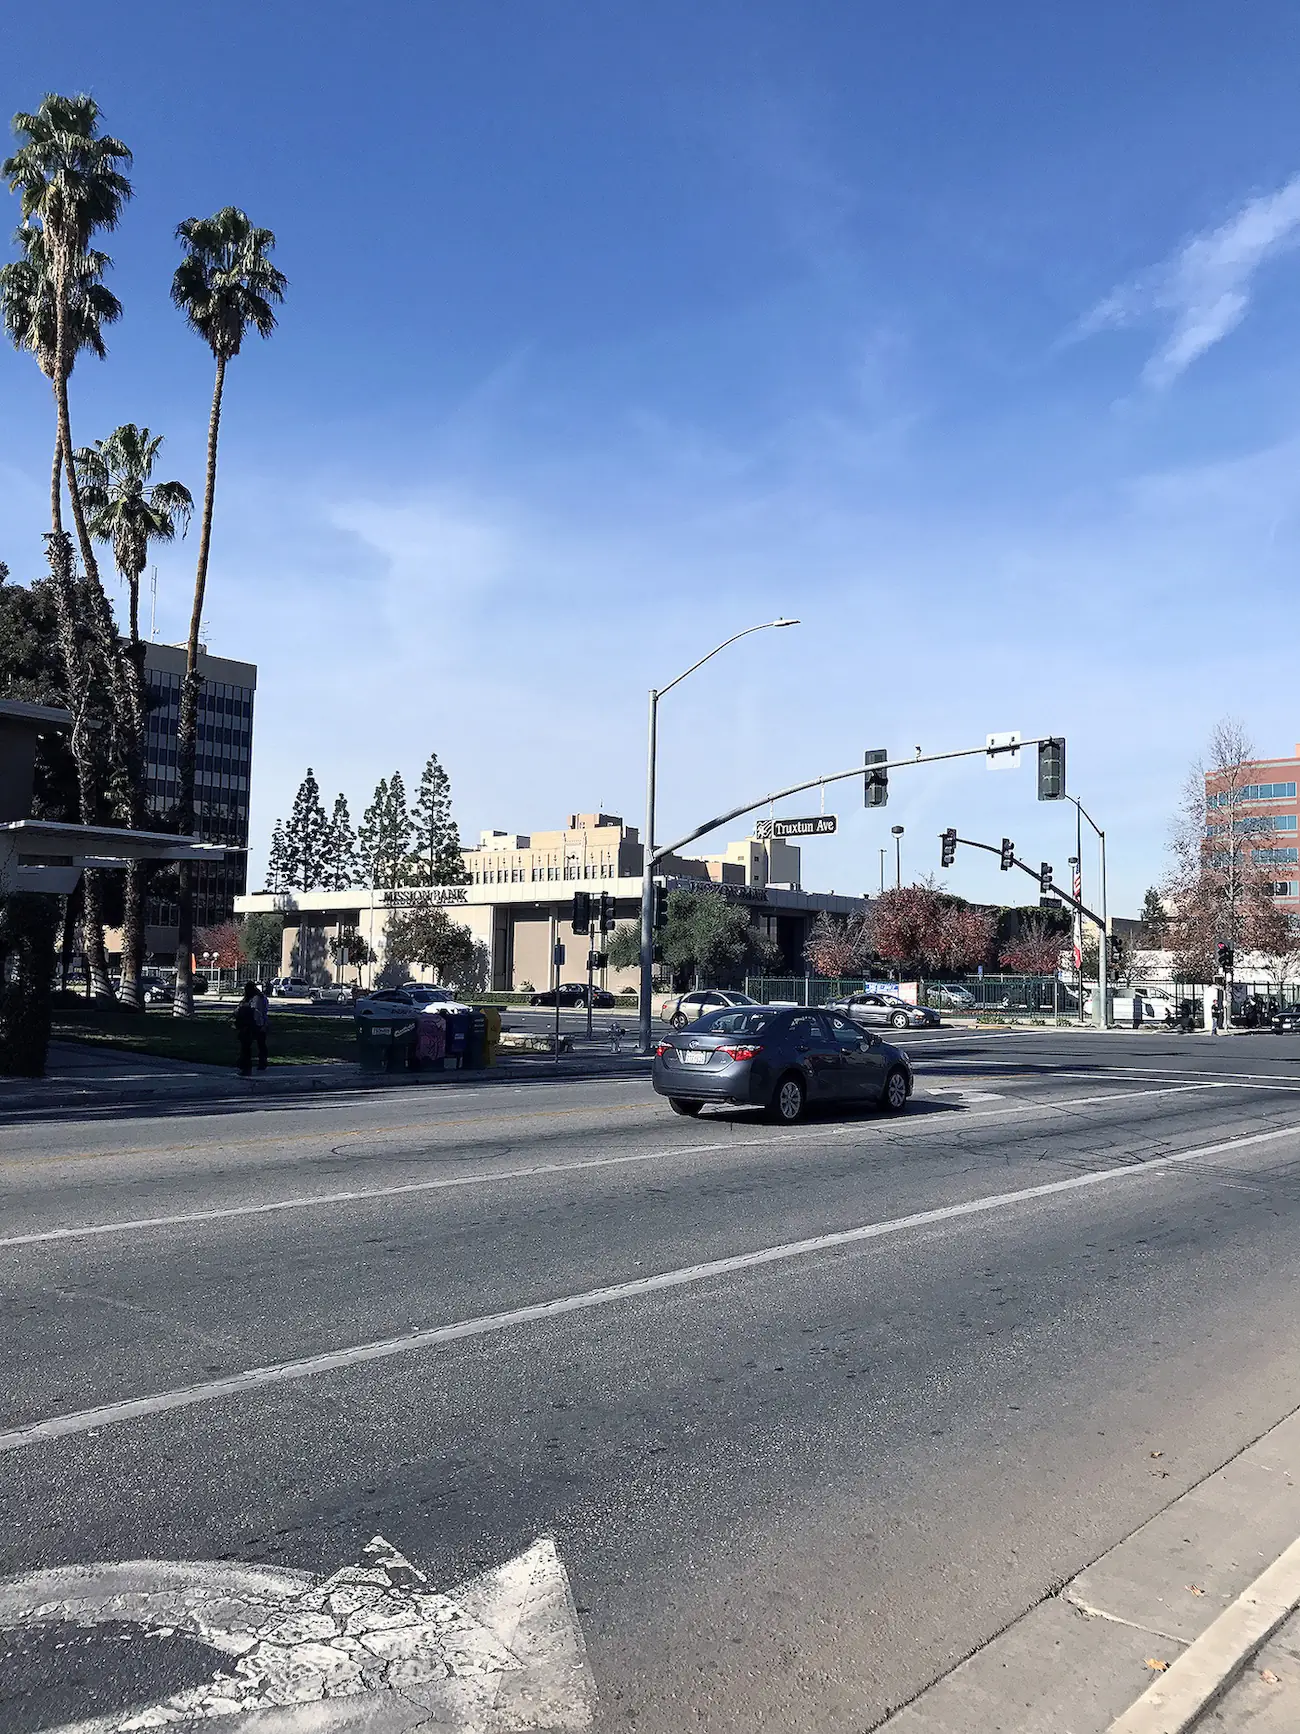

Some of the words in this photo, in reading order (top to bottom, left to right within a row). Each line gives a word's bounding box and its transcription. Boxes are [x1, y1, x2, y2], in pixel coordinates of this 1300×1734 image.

[775, 821, 814, 835] Truxtun
[816, 819, 834, 832] Ave
[431, 888, 469, 904] BANK
